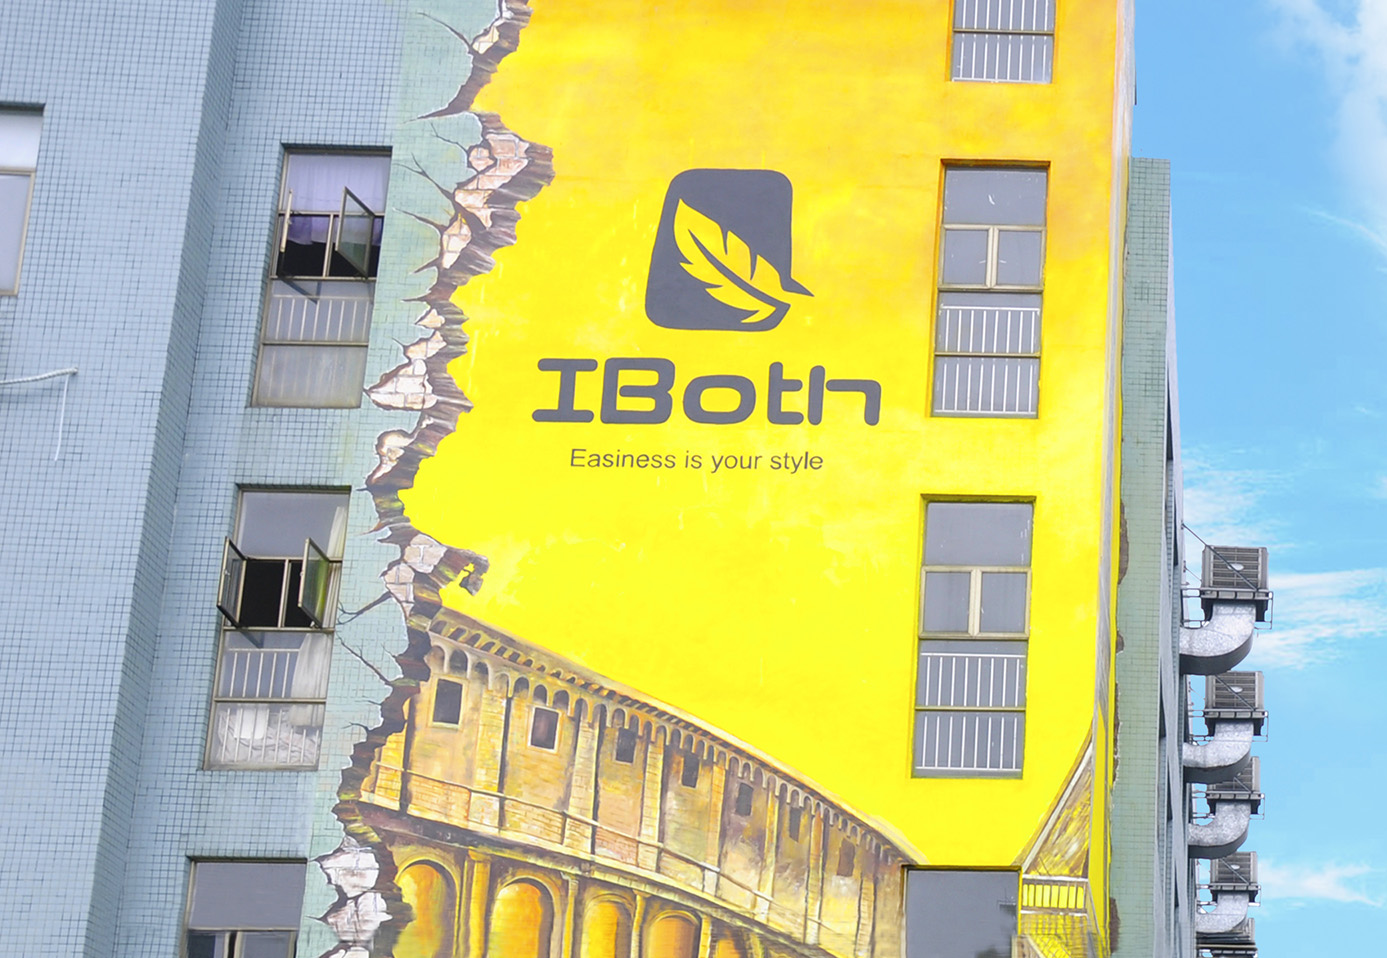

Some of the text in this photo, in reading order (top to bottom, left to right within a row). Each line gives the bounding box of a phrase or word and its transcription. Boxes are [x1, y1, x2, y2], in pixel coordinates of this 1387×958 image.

[531, 356, 882, 426] IBoth
[570, 448, 824, 475] Easiness is your style
